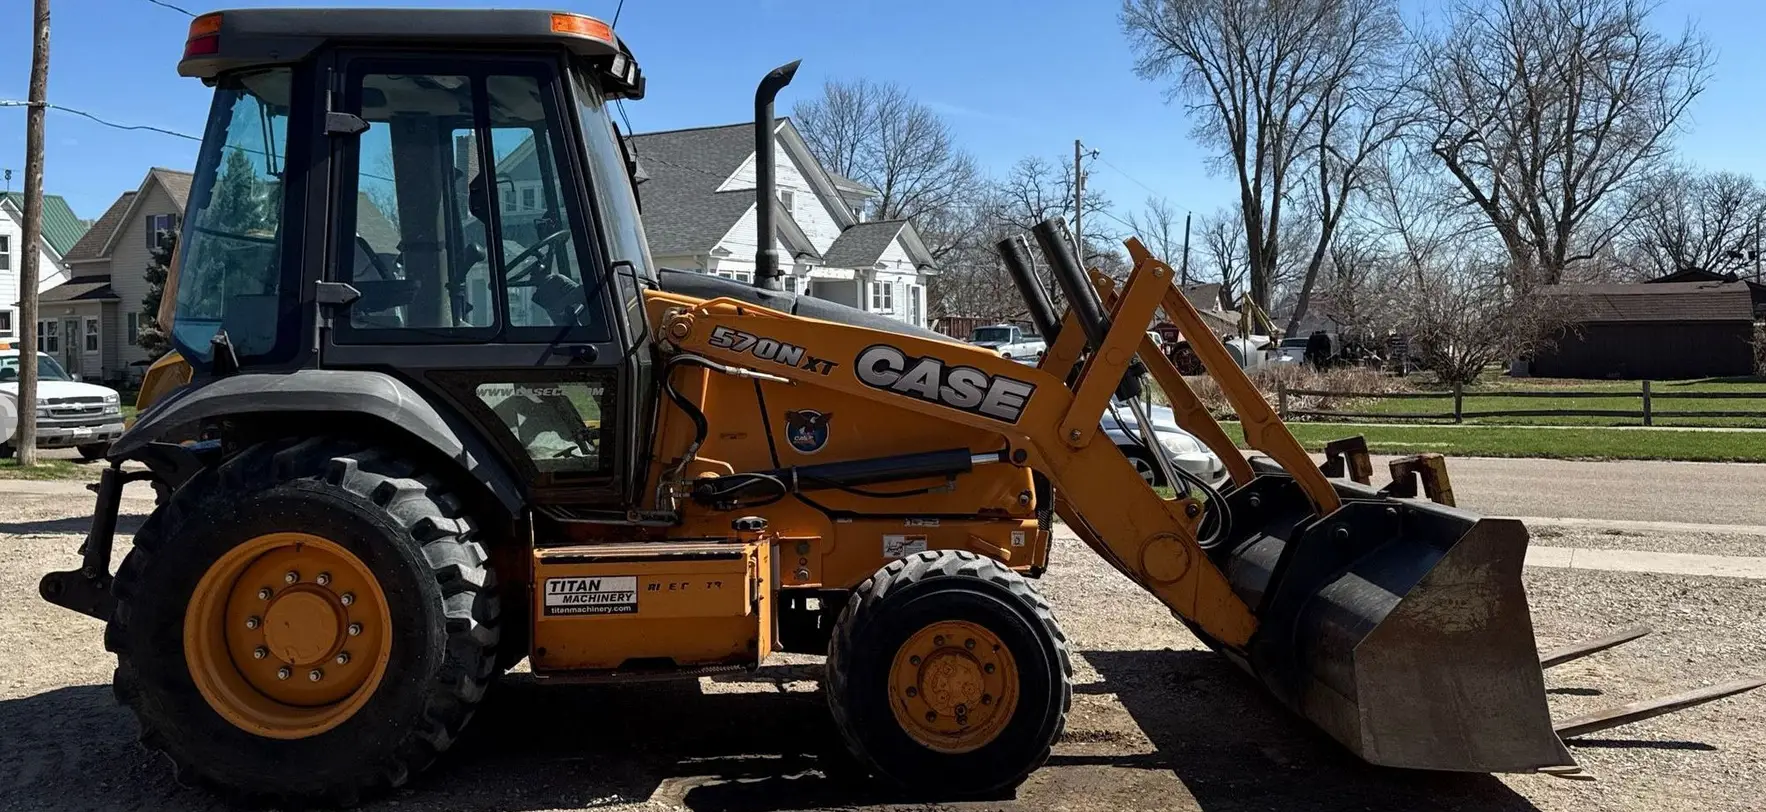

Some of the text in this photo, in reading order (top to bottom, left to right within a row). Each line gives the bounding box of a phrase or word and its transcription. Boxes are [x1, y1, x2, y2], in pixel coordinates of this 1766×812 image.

[708, 325, 839, 376] 570N XT
[853, 344, 1036, 424] CASE
[550, 580, 601, 592] TITAN
[563, 594, 632, 603] MACHINERY
[552, 605, 632, 613] titanmachinery.com
